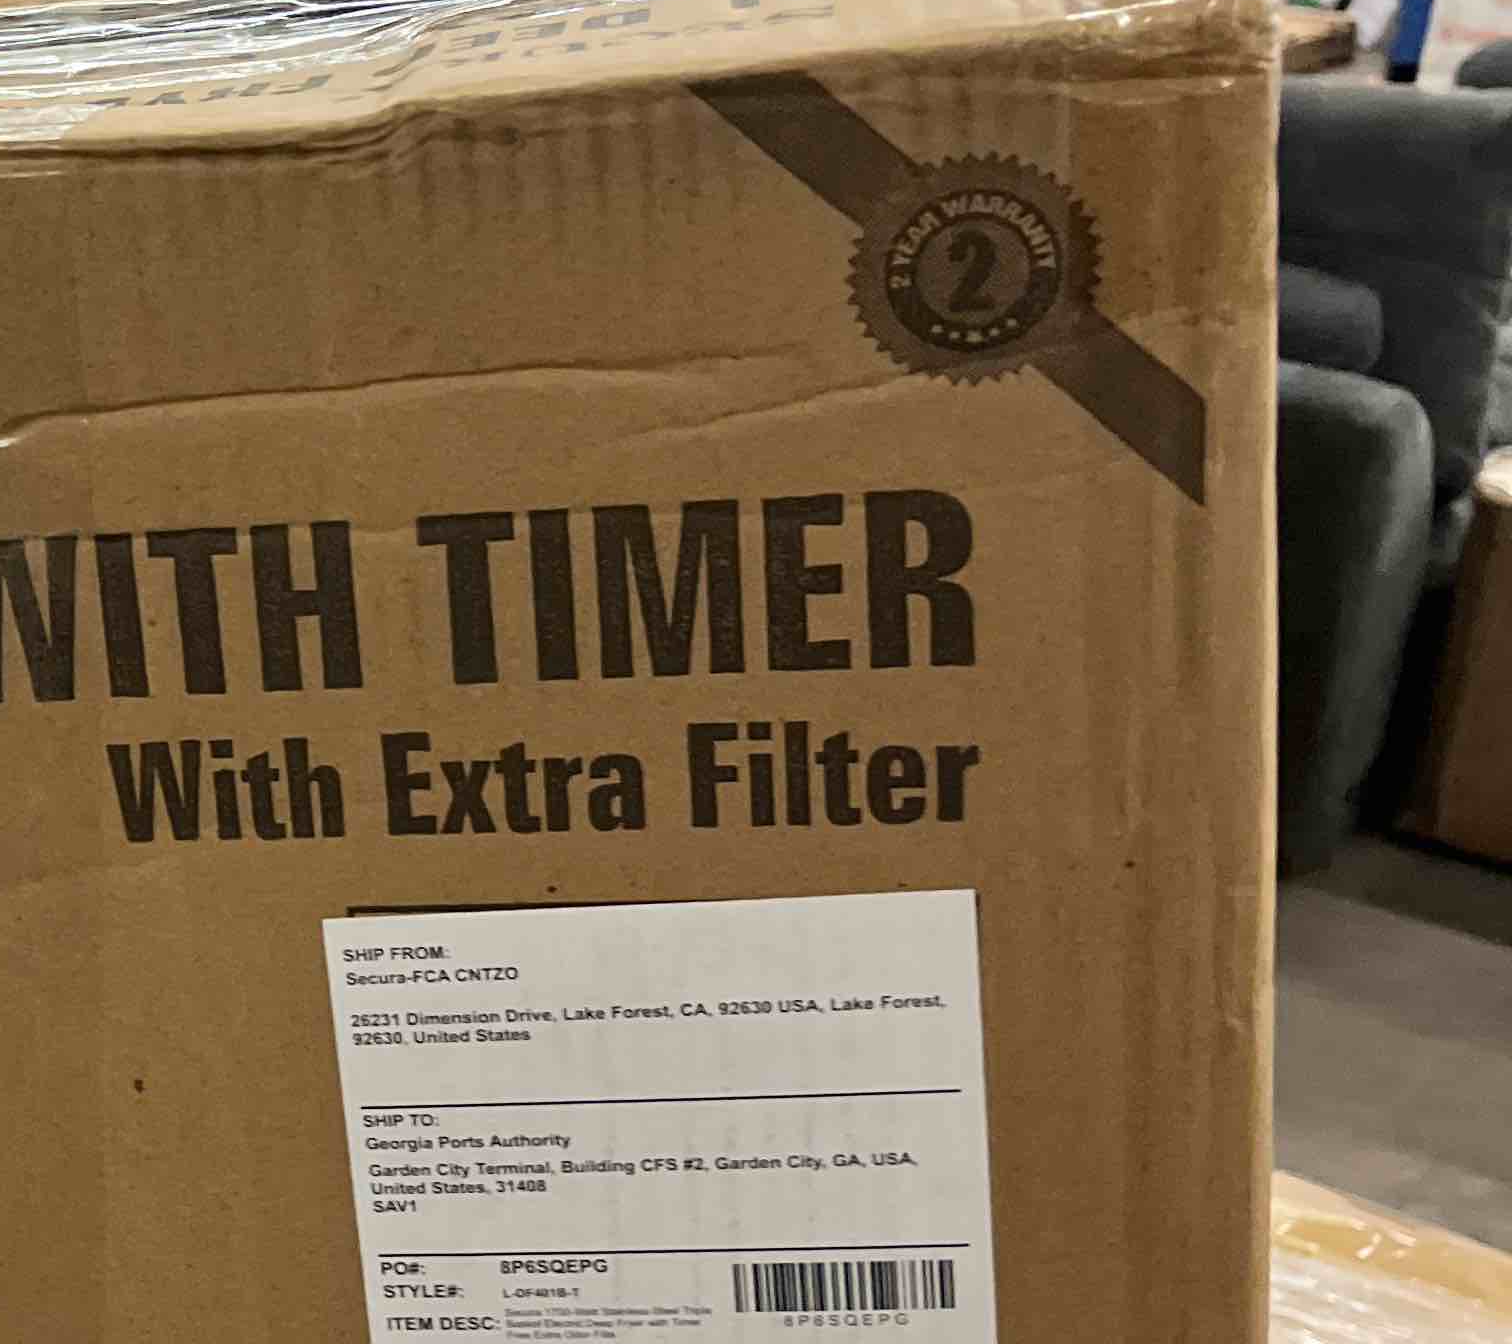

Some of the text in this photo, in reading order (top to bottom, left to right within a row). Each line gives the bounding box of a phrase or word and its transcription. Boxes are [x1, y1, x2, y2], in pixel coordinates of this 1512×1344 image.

[942, 194, 1056, 269] WARRANTY
[948, 229, 996, 312] 2
[416, 488, 977, 685] TIMER
[105, 720, 981, 843] With Extra Filter
[343, 946, 450, 962] SHIP FROM:
[346, 967, 519, 986] Secura-FCA CNTZO
[406, 1012, 501, 1025] Dimension
[506, 1010, 557, 1022] Drive,
[564, 1007, 606, 1020] Lake
[611, 1003, 674, 1019] Forest,
[718, 1002, 772, 1016] 92630
[778, 1000, 824, 1013] USA,
[831, 998, 874, 1011] Lake
[880, 995, 948, 1009] Forest,
[414, 1030, 470, 1044] United
[476, 1028, 530, 1042] States
[363, 1114, 439, 1127] SHIP TO:
[365, 1134, 570, 1152] Georgia Ports Authority
[369, 1163, 431, 1177] Garden
[437, 1163, 470, 1178] City
[476, 1162, 554, 1176] Terminal,
[561, 1161, 636, 1175] Building
[640, 1158, 676, 1172] CFS
[714, 1156, 781, 1170] Garden
[787, 1154, 826, 1171] City,
[832, 1154, 865, 1168] GA,
[371, 1182, 425, 1195] United
[431, 1181, 490, 1194] States,
[373, 1200, 417, 1213] SAV1
[381, 1259, 608, 1276] PO#: 8P6SQEPG
[383, 1284, 464, 1298] STYLE#:
[386, 1317, 433, 1331] ITEM
[439, 1316, 502, 1330] DESC:
